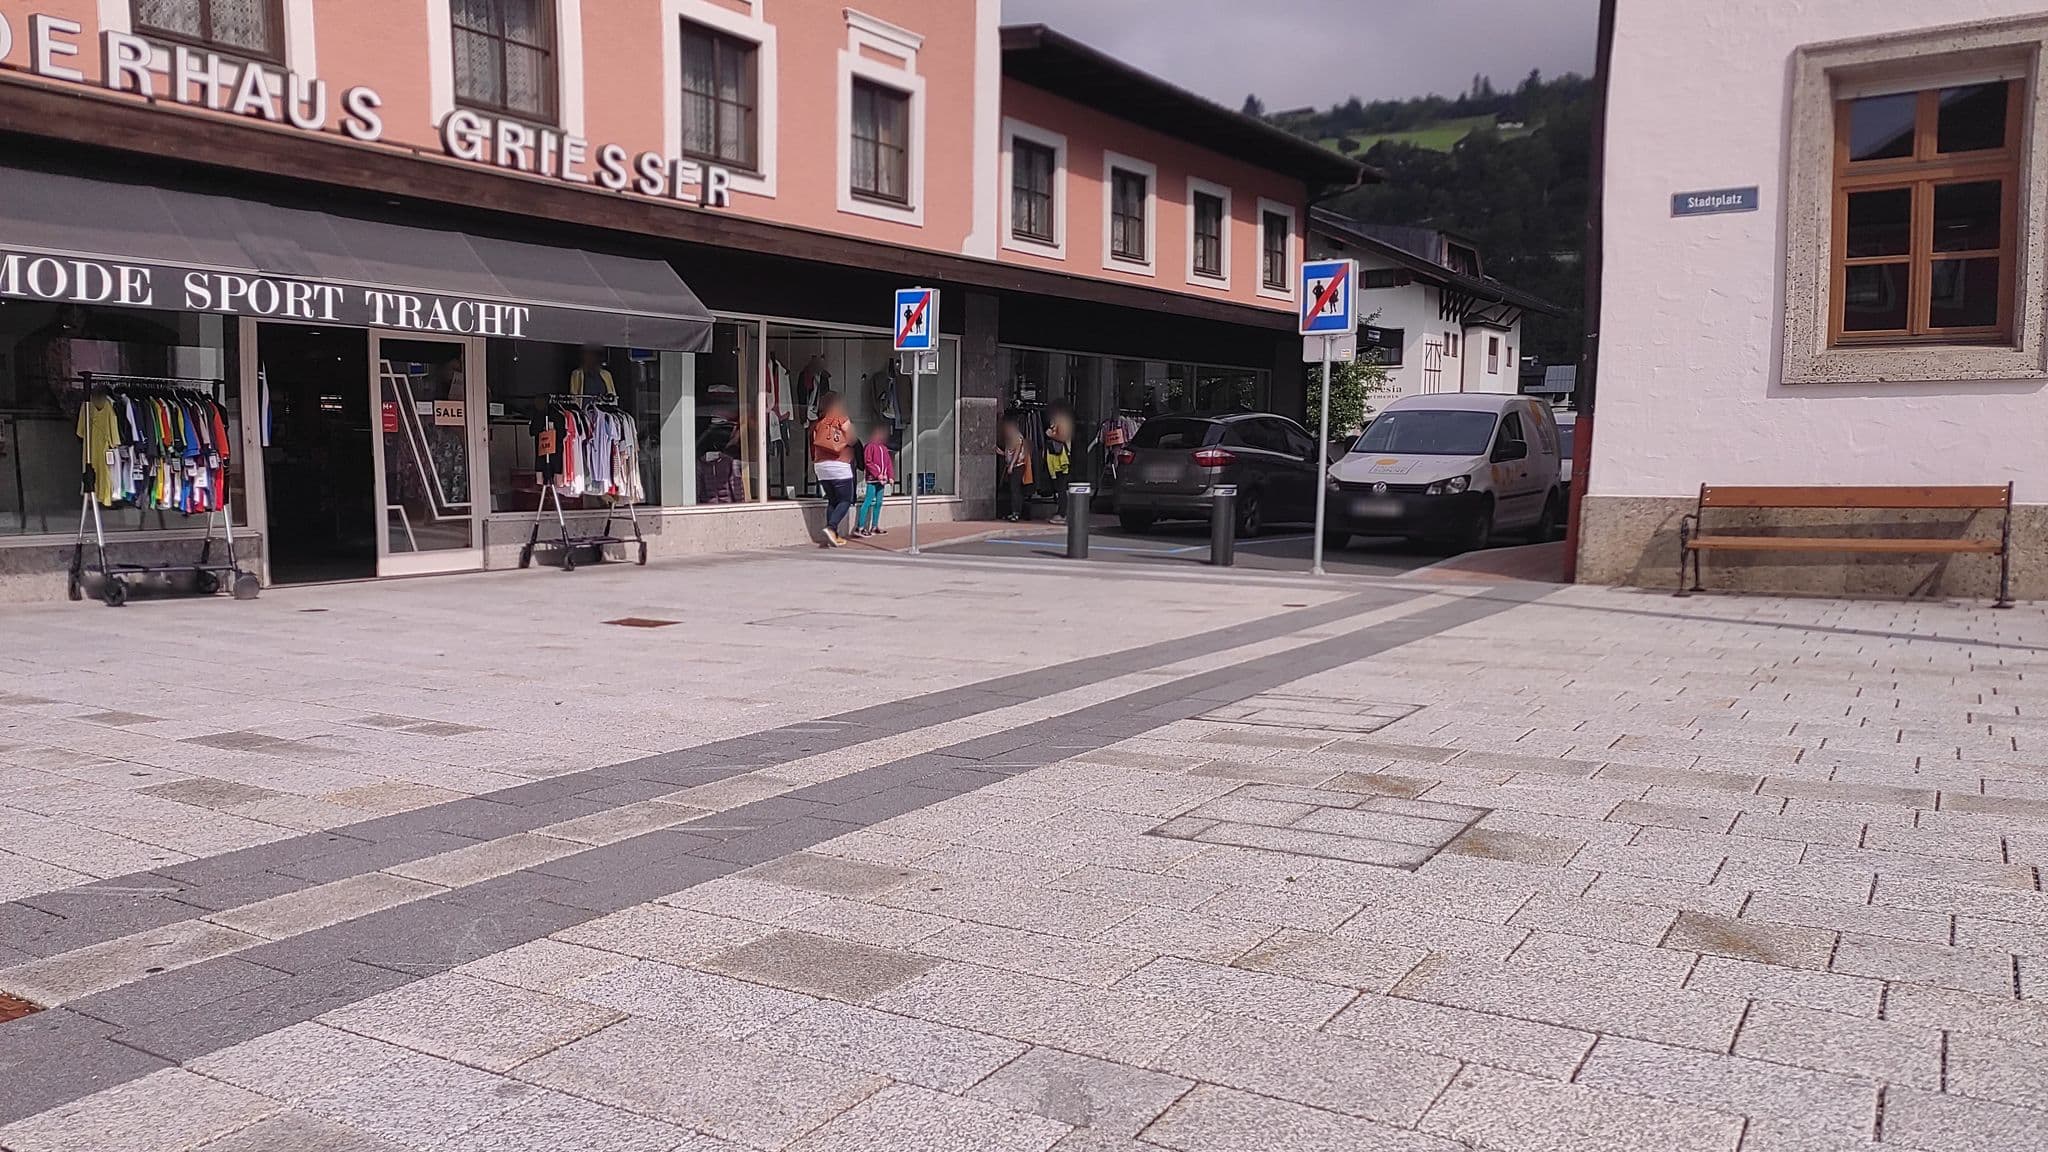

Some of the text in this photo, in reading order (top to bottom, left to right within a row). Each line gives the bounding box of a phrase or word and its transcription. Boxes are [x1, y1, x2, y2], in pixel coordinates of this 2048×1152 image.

[0, 11, 731, 208] ERHAUS GRIESSER
[1688, 194, 1742, 208] Stadtplatz
[184, 272, 343, 321] SPORT
[365, 290, 529, 337] TRACHT
[436, 408, 463, 417] SALE
